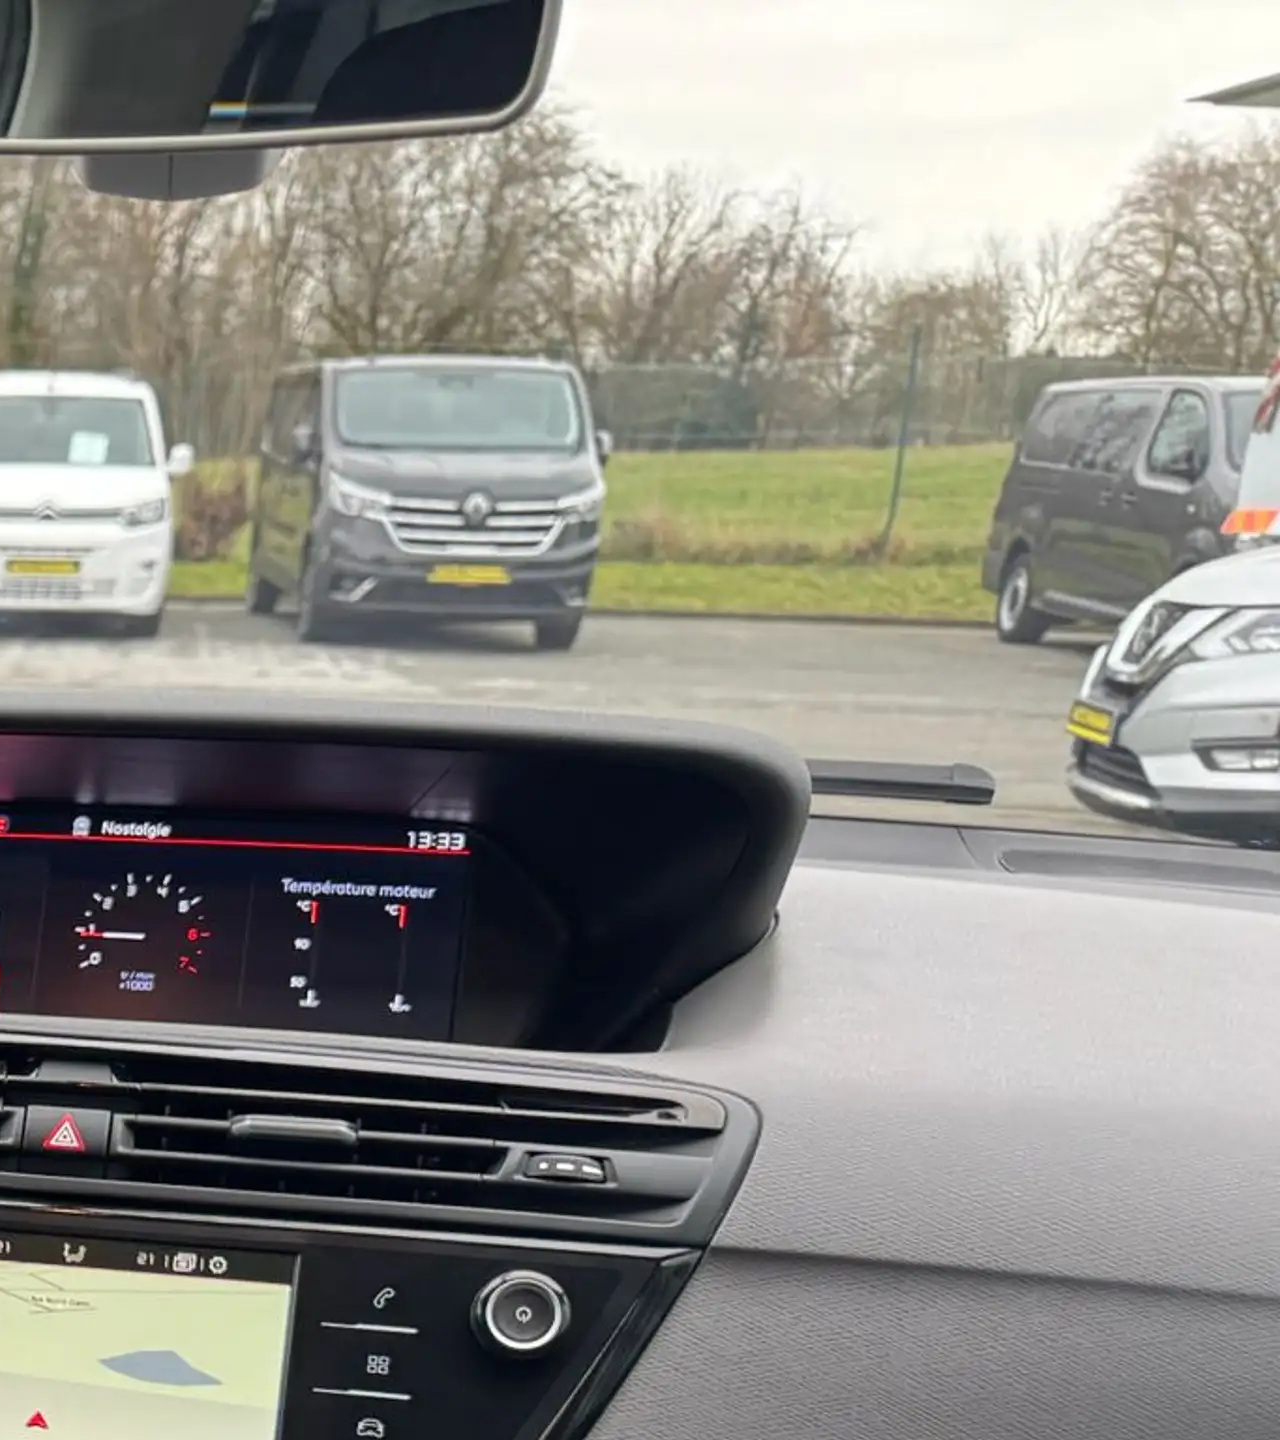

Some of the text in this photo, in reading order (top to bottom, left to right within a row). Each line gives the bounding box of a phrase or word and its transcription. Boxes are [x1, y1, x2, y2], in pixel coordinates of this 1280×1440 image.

[100, 820, 173, 839] Nostalgie
[406, 830, 467, 851] 13:33
[281, 877, 438, 900] Température moteur
[186, 927, 200, 942] 6
[88, 951, 103, 966] 0
[178, 955, 190, 969] 7
